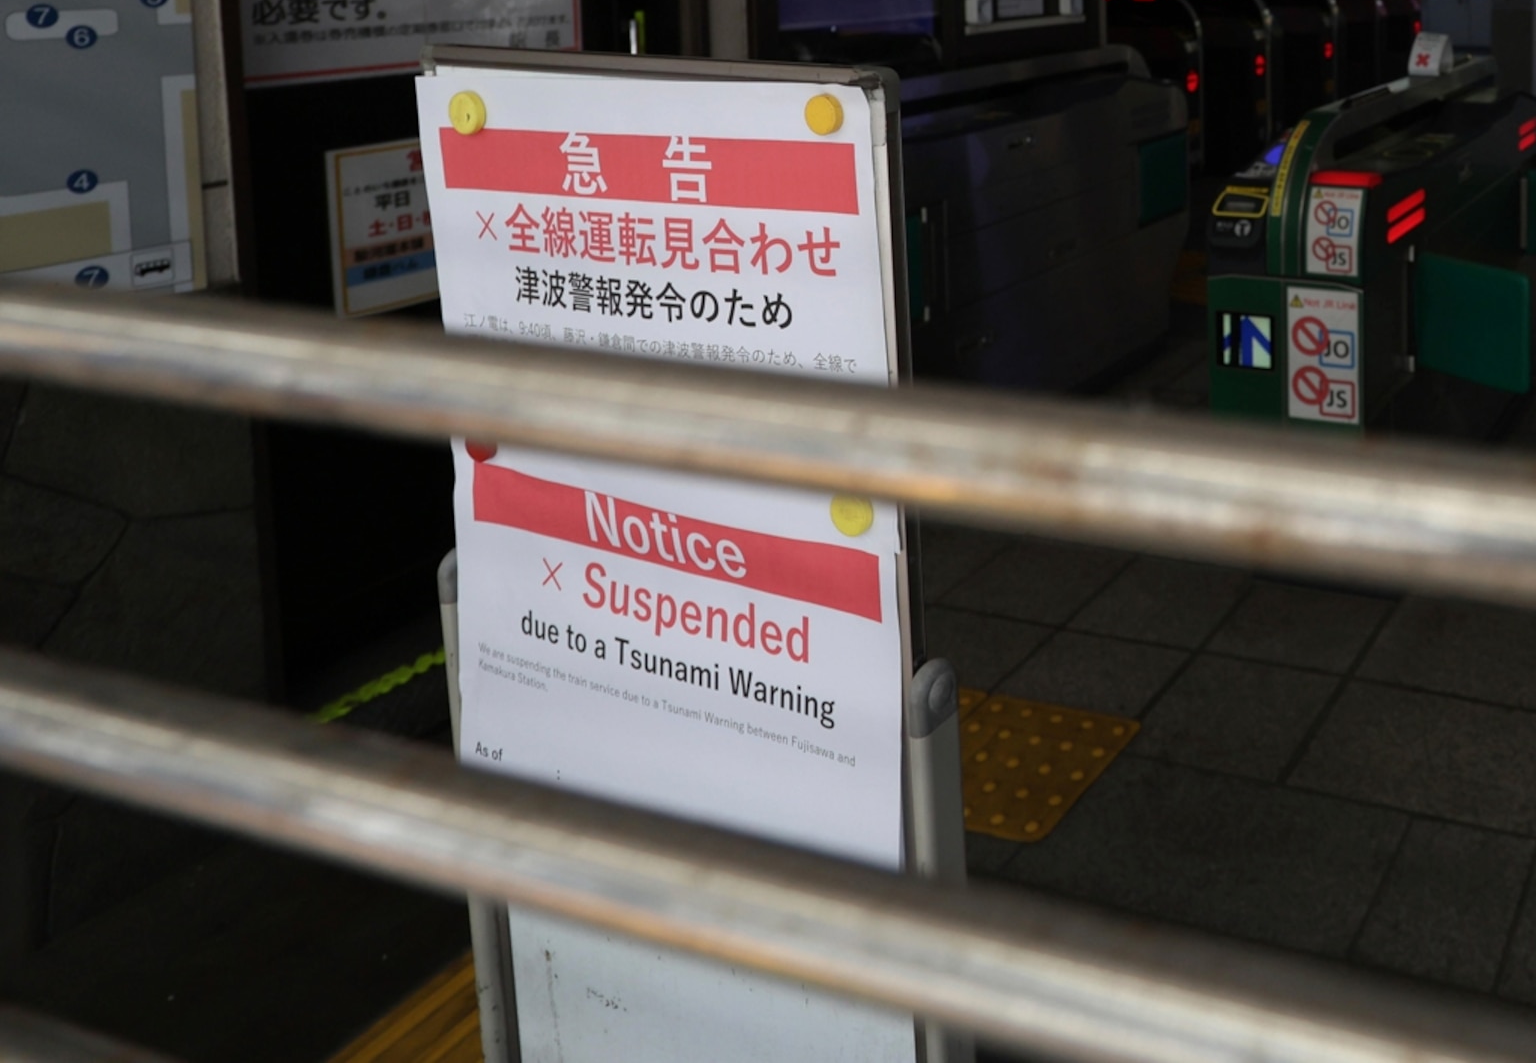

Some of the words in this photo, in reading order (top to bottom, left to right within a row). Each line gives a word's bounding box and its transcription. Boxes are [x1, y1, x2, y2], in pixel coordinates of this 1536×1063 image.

[376, 190, 410, 211] 平日
[505, 203, 841, 277] 全線運転見合わせ
[515, 266, 793, 329] 津波警報発令のため
[1326, 390, 1347, 408] JS
[584, 490, 748, 579] Notice
[583, 562, 810, 664] Suspended
[478, 658, 516, 681] Kamakura
[521, 610, 559, 645] due
[566, 624, 586, 653] to
[594, 639, 606, 659] a
[615, 637, 719, 691] Tsunami
[729, 666, 835, 729] Warning
[506, 654, 551, 678] suspending
[553, 668, 566, 681] the
[568, 673, 588, 687] train
[589, 680, 621, 698] service
[622, 689, 640, 703] due
[641, 693, 651, 706] to
[661, 699, 702, 721] Tsunami
[704, 711, 745, 735] Warning
[746, 724, 789, 745] between
[791, 736, 835, 760] Fujisawa
[837, 753, 856, 767] and
[475, 741, 489, 757] As
[492, 748, 503, 761] of
